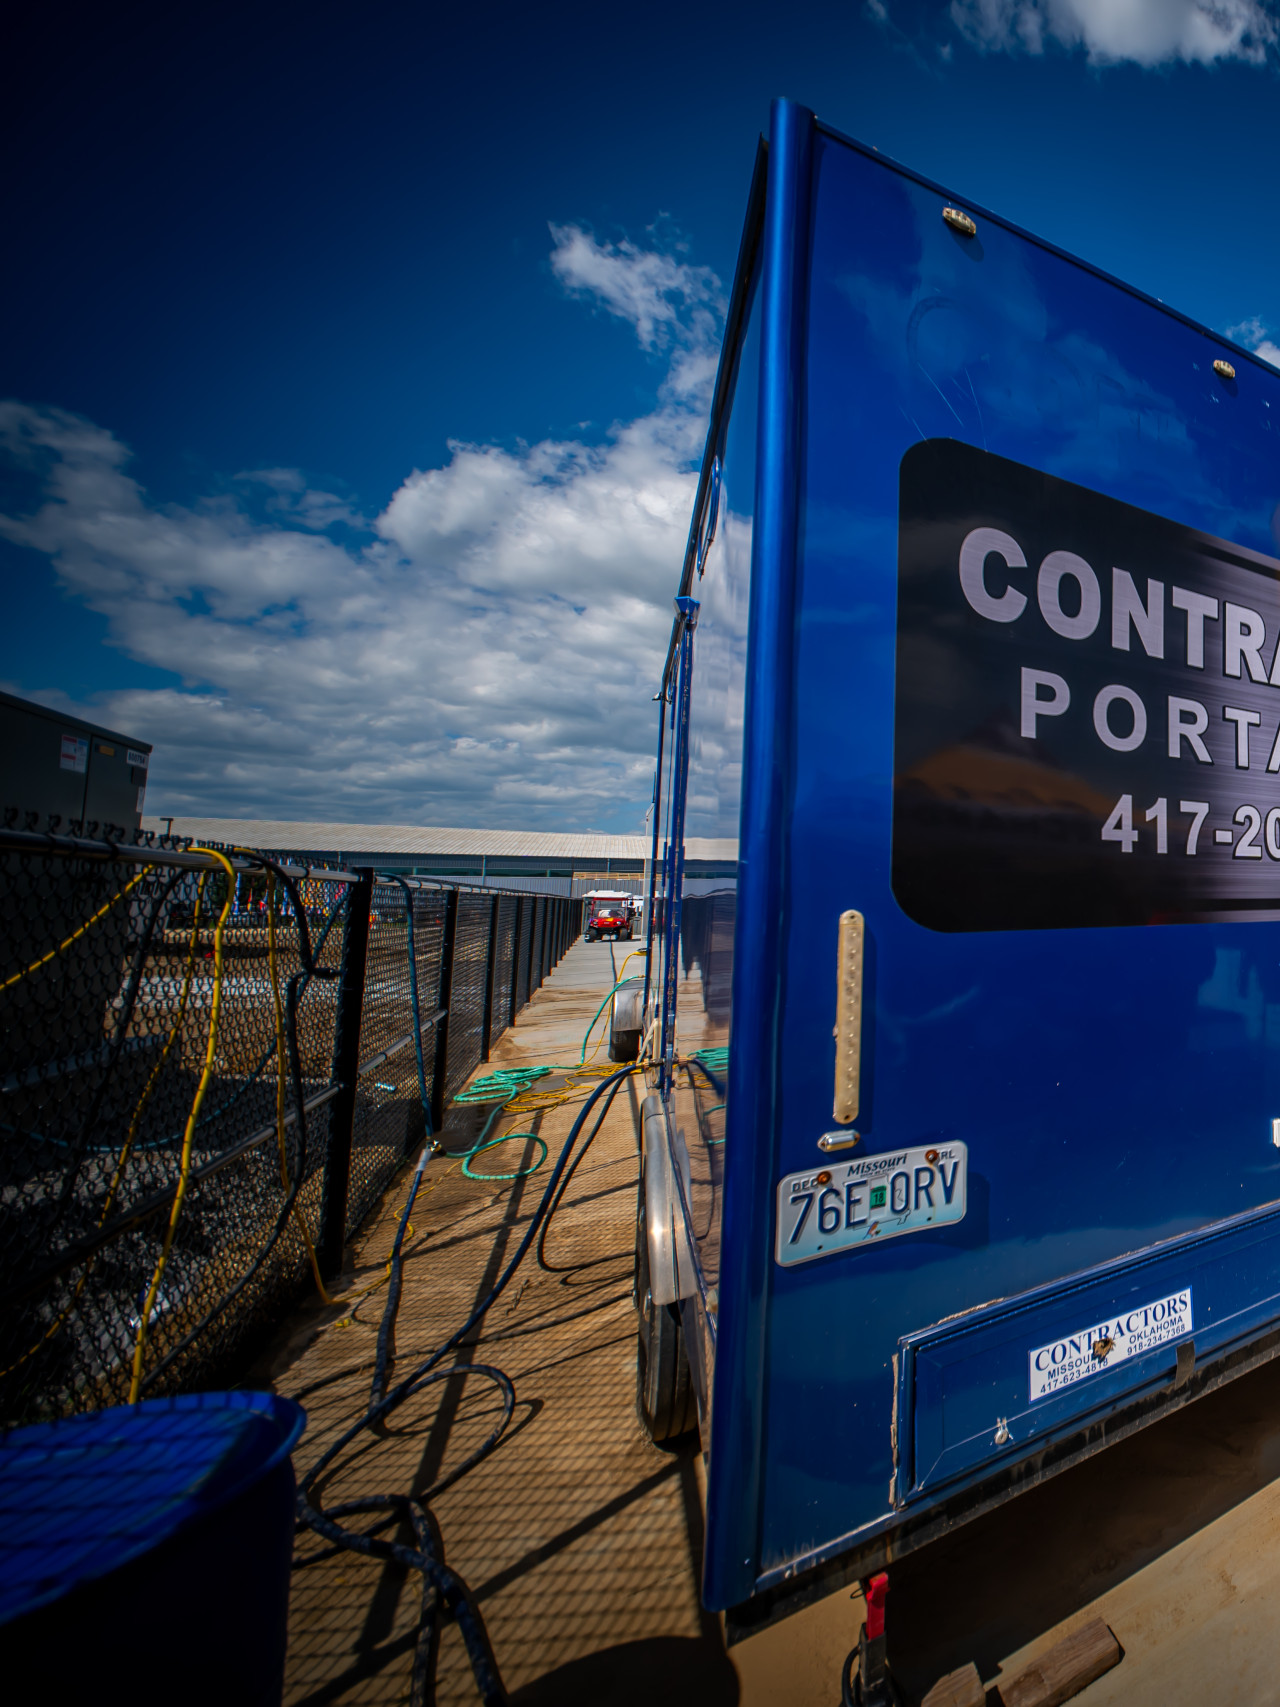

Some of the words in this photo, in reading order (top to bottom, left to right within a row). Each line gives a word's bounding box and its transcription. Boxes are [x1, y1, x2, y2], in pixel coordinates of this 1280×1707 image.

[847, 1153, 908, 1177] Missouri
[789, 1179, 869, 1245] 76E
[1035, 1293, 1188, 1372] CONTRACTORS
[1126, 1323, 1186, 1356] 918-234-7368
[1129, 1315, 1183, 1344] OKLAHOMA
[1047, 1351, 1101, 1381] MISSOU
